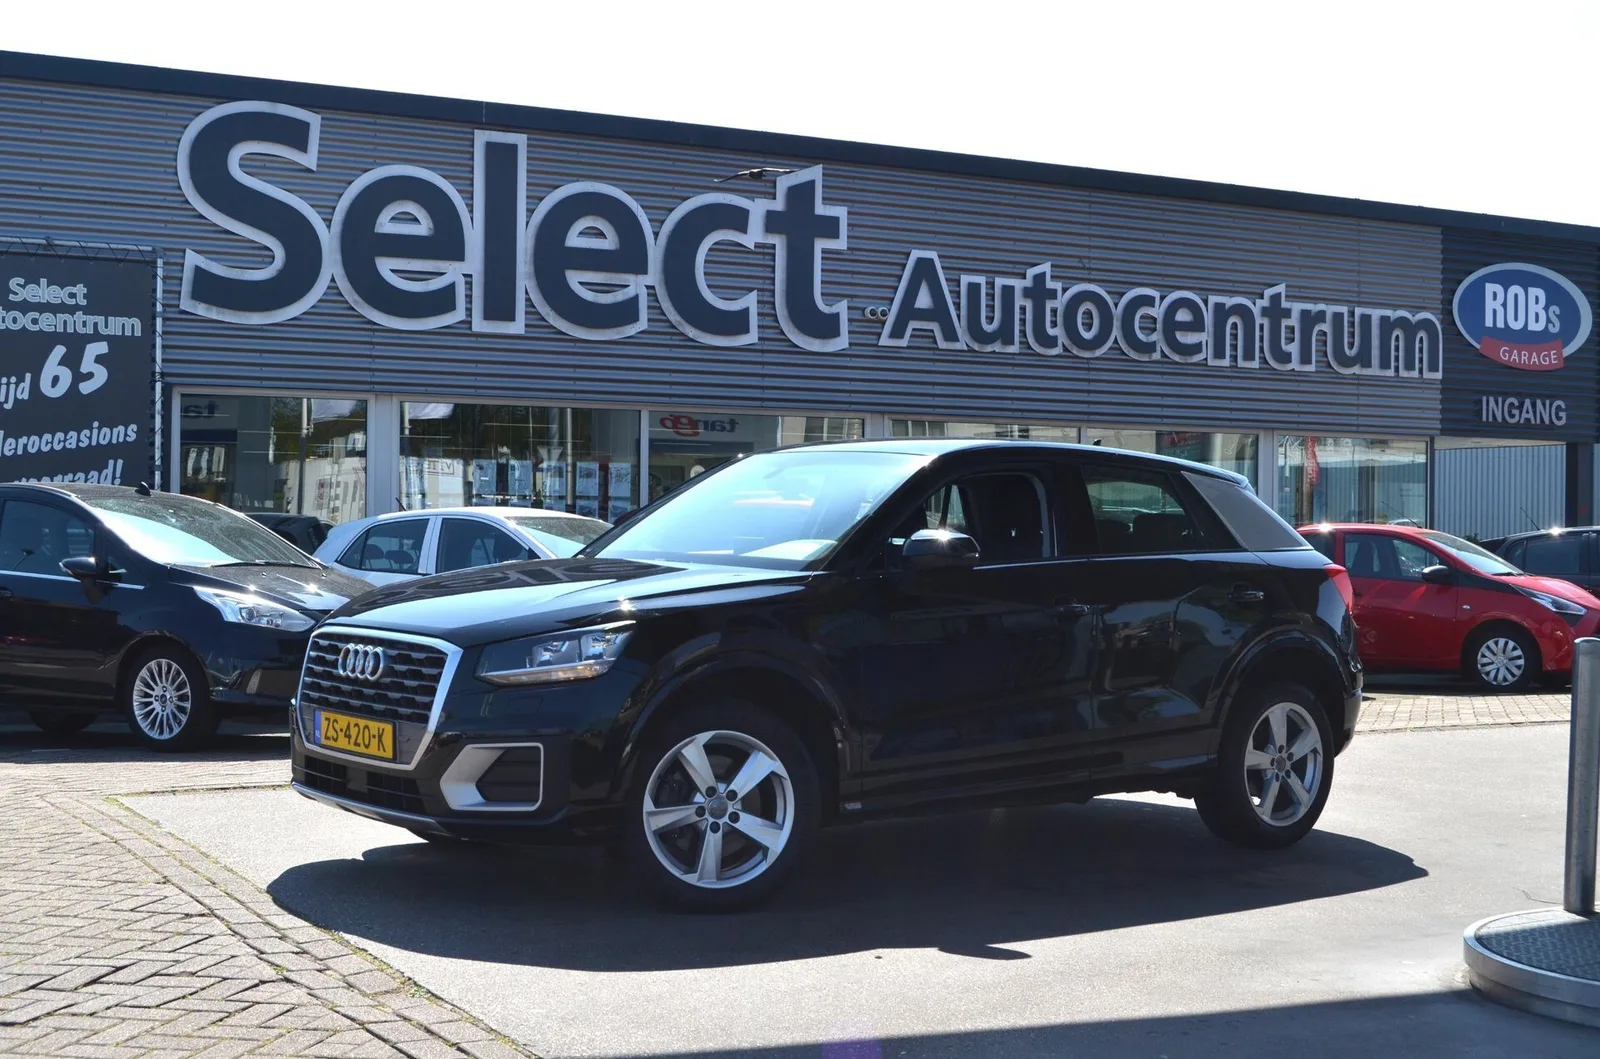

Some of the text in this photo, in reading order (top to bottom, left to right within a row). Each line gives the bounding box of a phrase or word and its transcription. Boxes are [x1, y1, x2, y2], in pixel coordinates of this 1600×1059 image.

[177, 100, 1443, 379] Select Autocentrum
[8, 277, 87, 305] Select
[1485, 282, 1561, 333] ROBs
[39, 341, 109, 398] 65
[1500, 346, 1558, 365] GARAGE
[1482, 396, 1566, 426] INGANG
[324, 716, 387, 753] ZS-420-K
